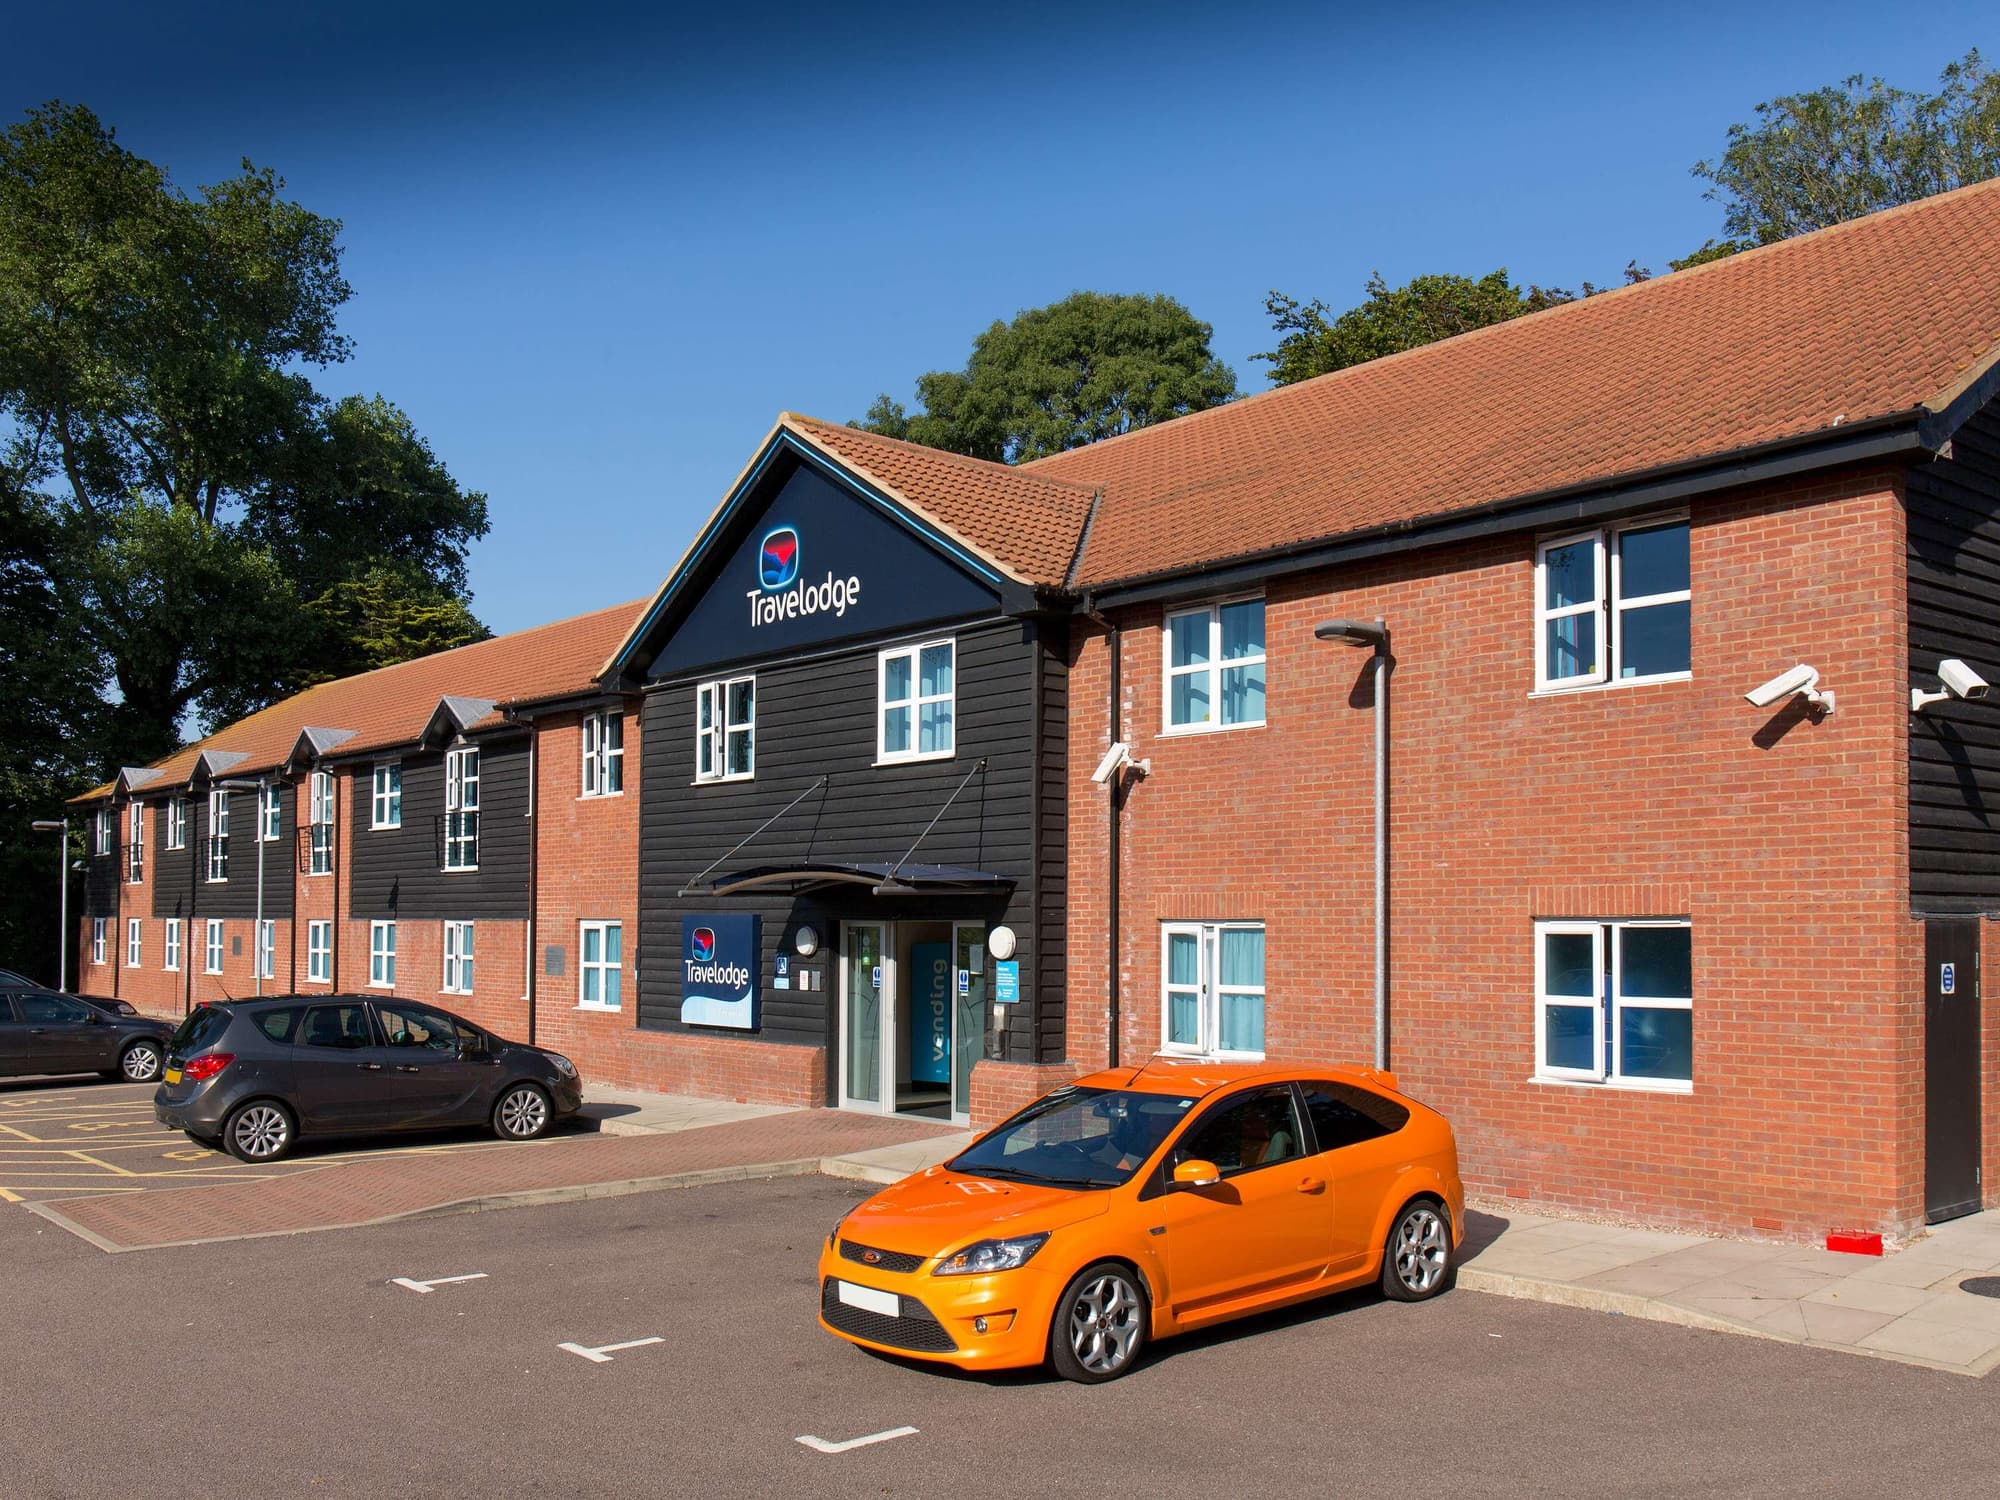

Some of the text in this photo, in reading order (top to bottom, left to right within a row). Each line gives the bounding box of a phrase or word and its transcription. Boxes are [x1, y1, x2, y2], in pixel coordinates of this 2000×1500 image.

[746, 571, 860, 627] Travelodge
[685, 960, 749, 990] Travelodge
[930, 959, 948, 1062] vending
